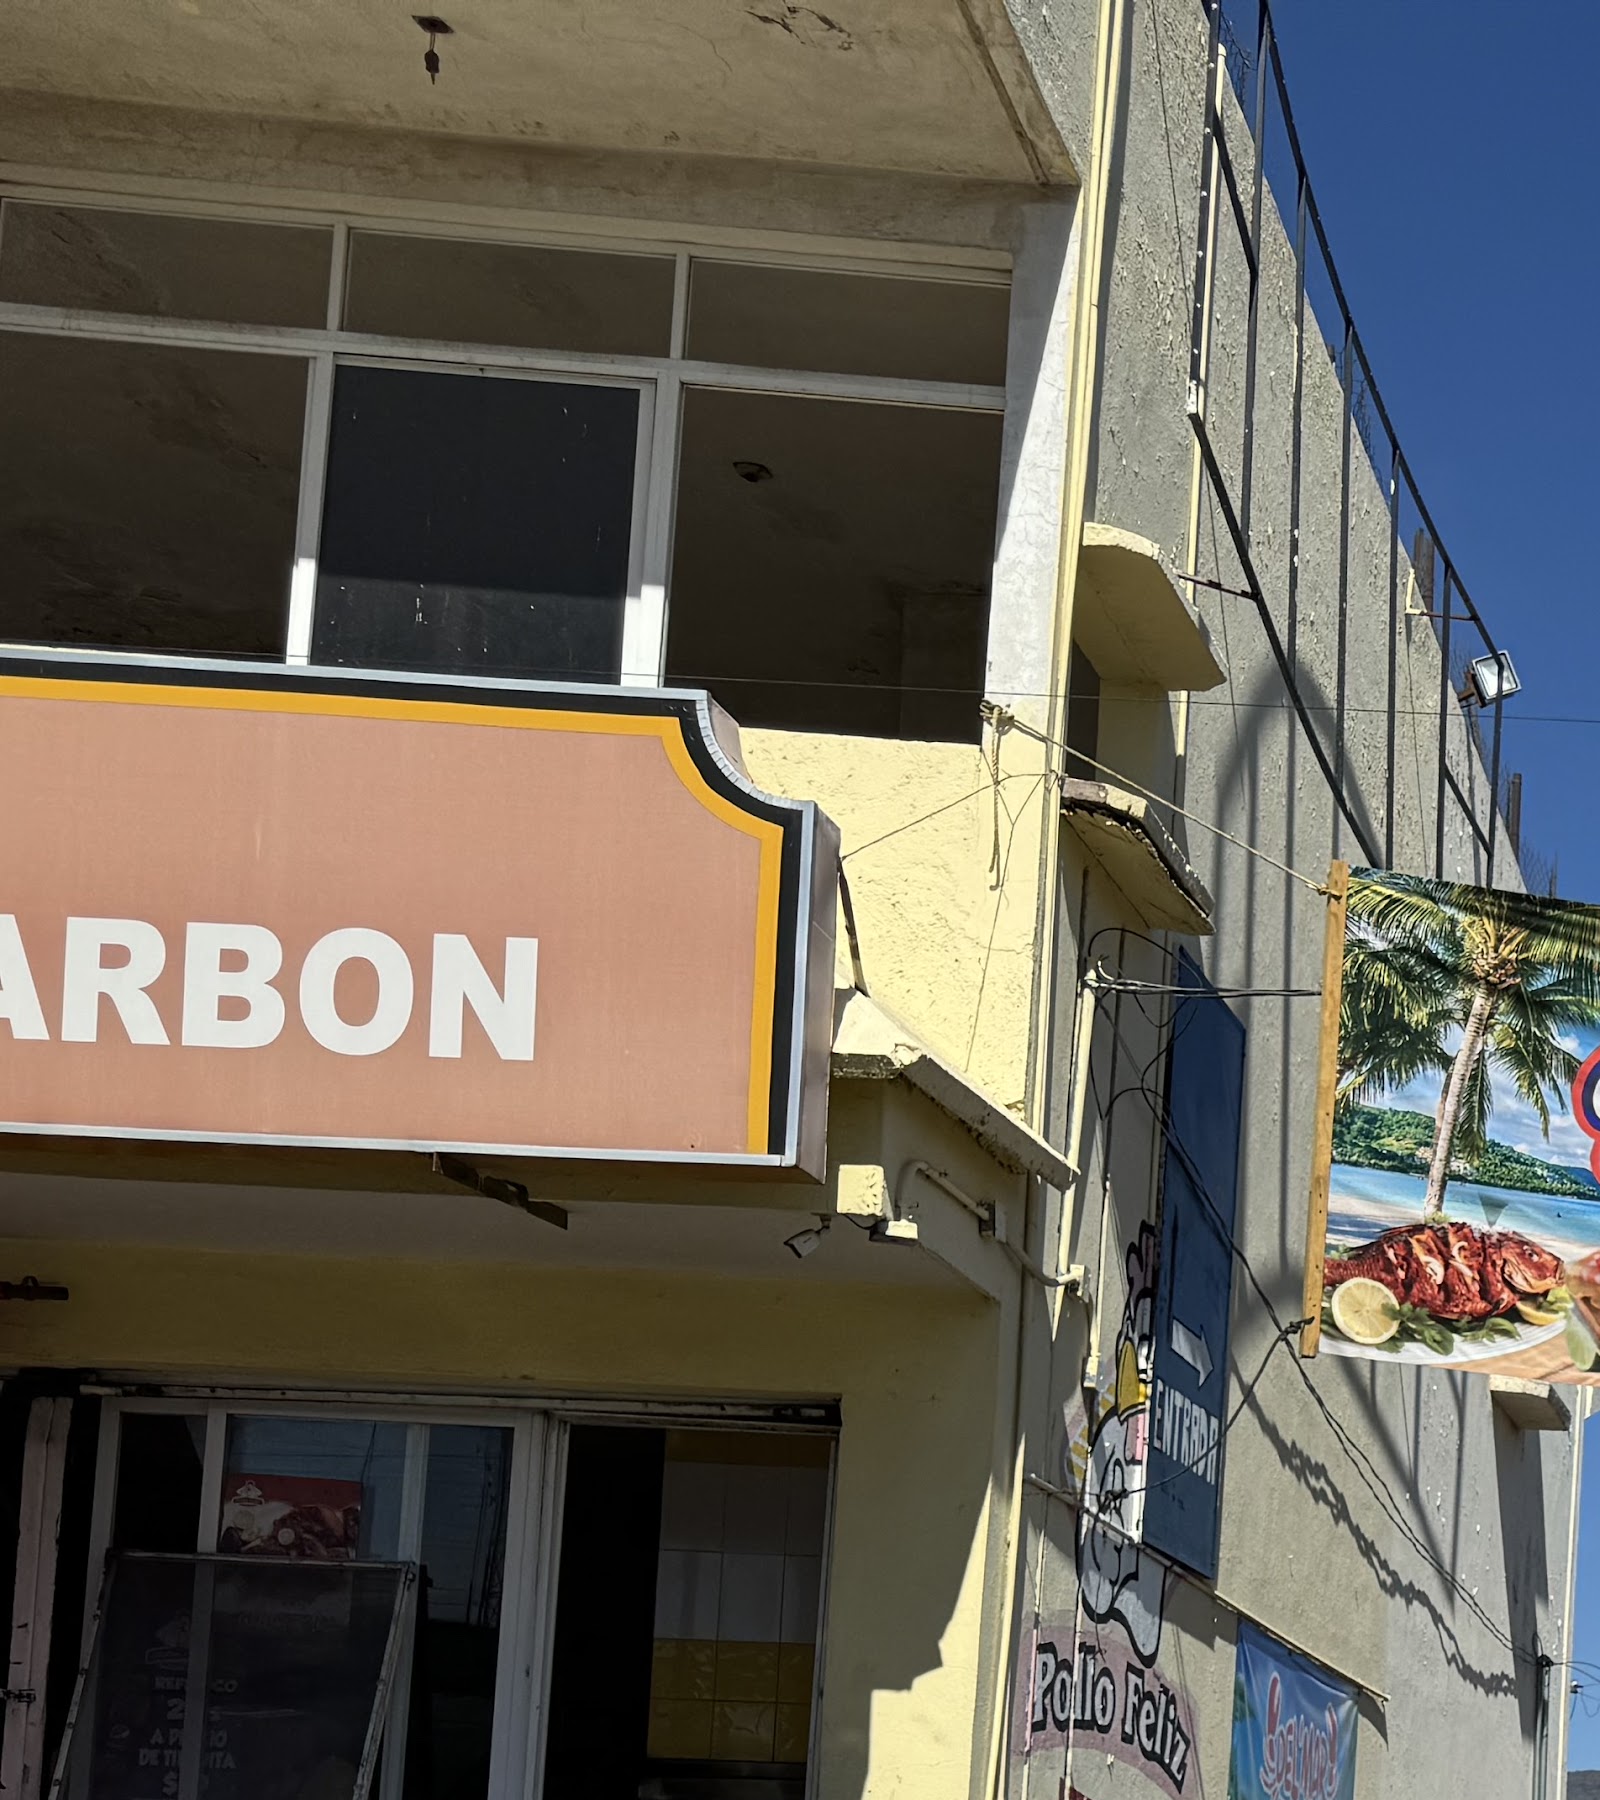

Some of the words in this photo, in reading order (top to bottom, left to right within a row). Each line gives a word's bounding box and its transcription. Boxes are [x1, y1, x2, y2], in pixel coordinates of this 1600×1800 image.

[1153, 1378, 1220, 1486] ENTRADA
[1030, 1641, 1116, 1734] Pollo
[1121, 1661, 1191, 1795] Feliz
